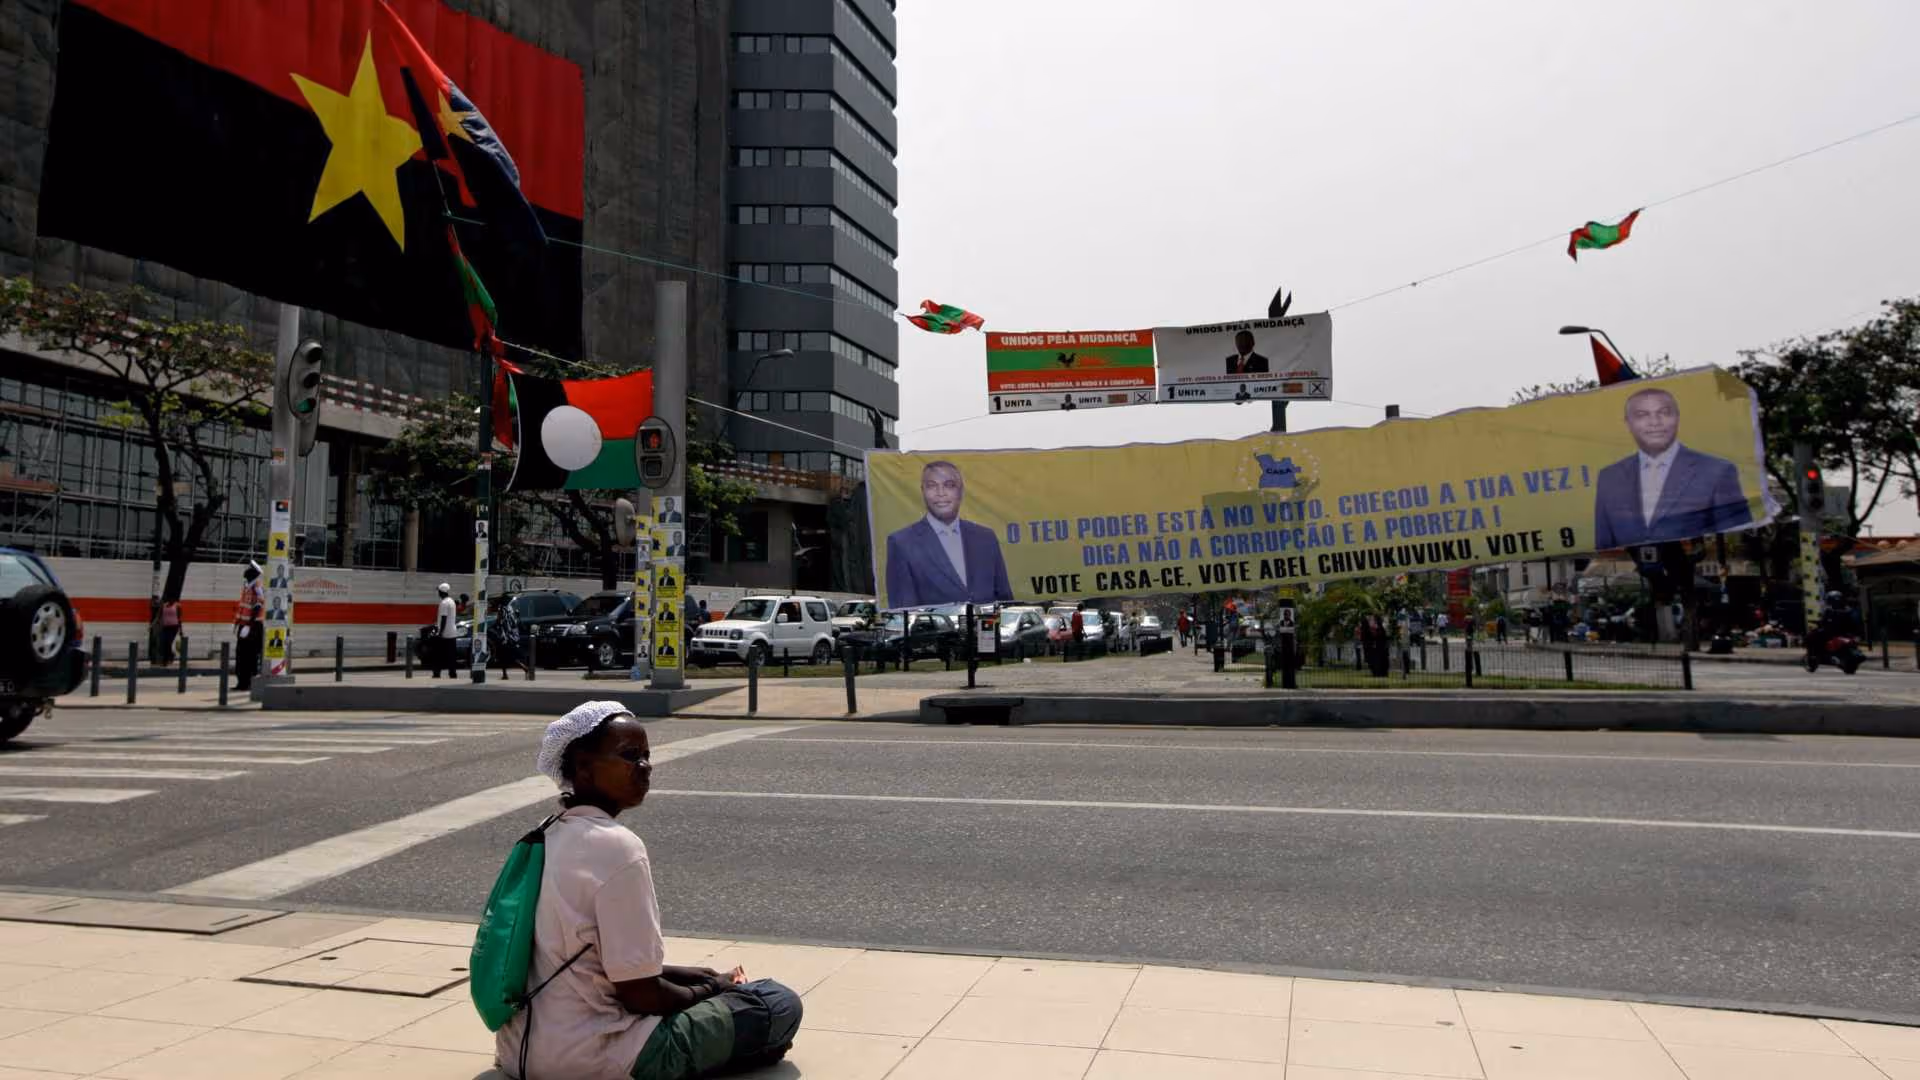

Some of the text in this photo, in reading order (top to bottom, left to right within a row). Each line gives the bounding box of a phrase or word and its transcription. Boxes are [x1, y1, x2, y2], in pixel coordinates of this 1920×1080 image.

[1186, 317, 1306, 335] UNIDOS PELA MUDANÇA
[1000, 333, 1138, 346] UNIDOS PELA MUDANÇA
[1168, 387, 1175, 399] 1
[1178, 389, 1206, 397] UNITA
[993, 396, 1001, 411] 1
[1004, 400, 1032, 408] UNITA
[1265, 467, 1293, 475] CASA
[1006, 522, 1020, 544] O
[1028, 519, 1069, 543] TEU
[1077, 513, 1148, 539] PODER
[1157, 502, 1215, 534] ESTÁ
[1223, 504, 1254, 528] NO
[1262, 498, 1331, 524] VOTO.
[1338, 485, 1429, 516] CHEGOU
[1440, 482, 1456, 505] A
[1464, 474, 1515, 502] TUA
[1523, 466, 1572, 494] VEZ
[1083, 543, 1130, 567] DIGA
[1137, 535, 1181, 562] NÃO
[1189, 537, 1203, 559] A
[1210, 522, 1335, 558] CORRUPÇÃO
[1342, 522, 1355, 545] E
[1364, 520, 1378, 542] A
[1385, 507, 1487, 540] POBREZA
[1031, 527, 1576, 595] VOTE CASA-CE. VOTE ABEL CHIVUKUVUKU. VOTE 9
